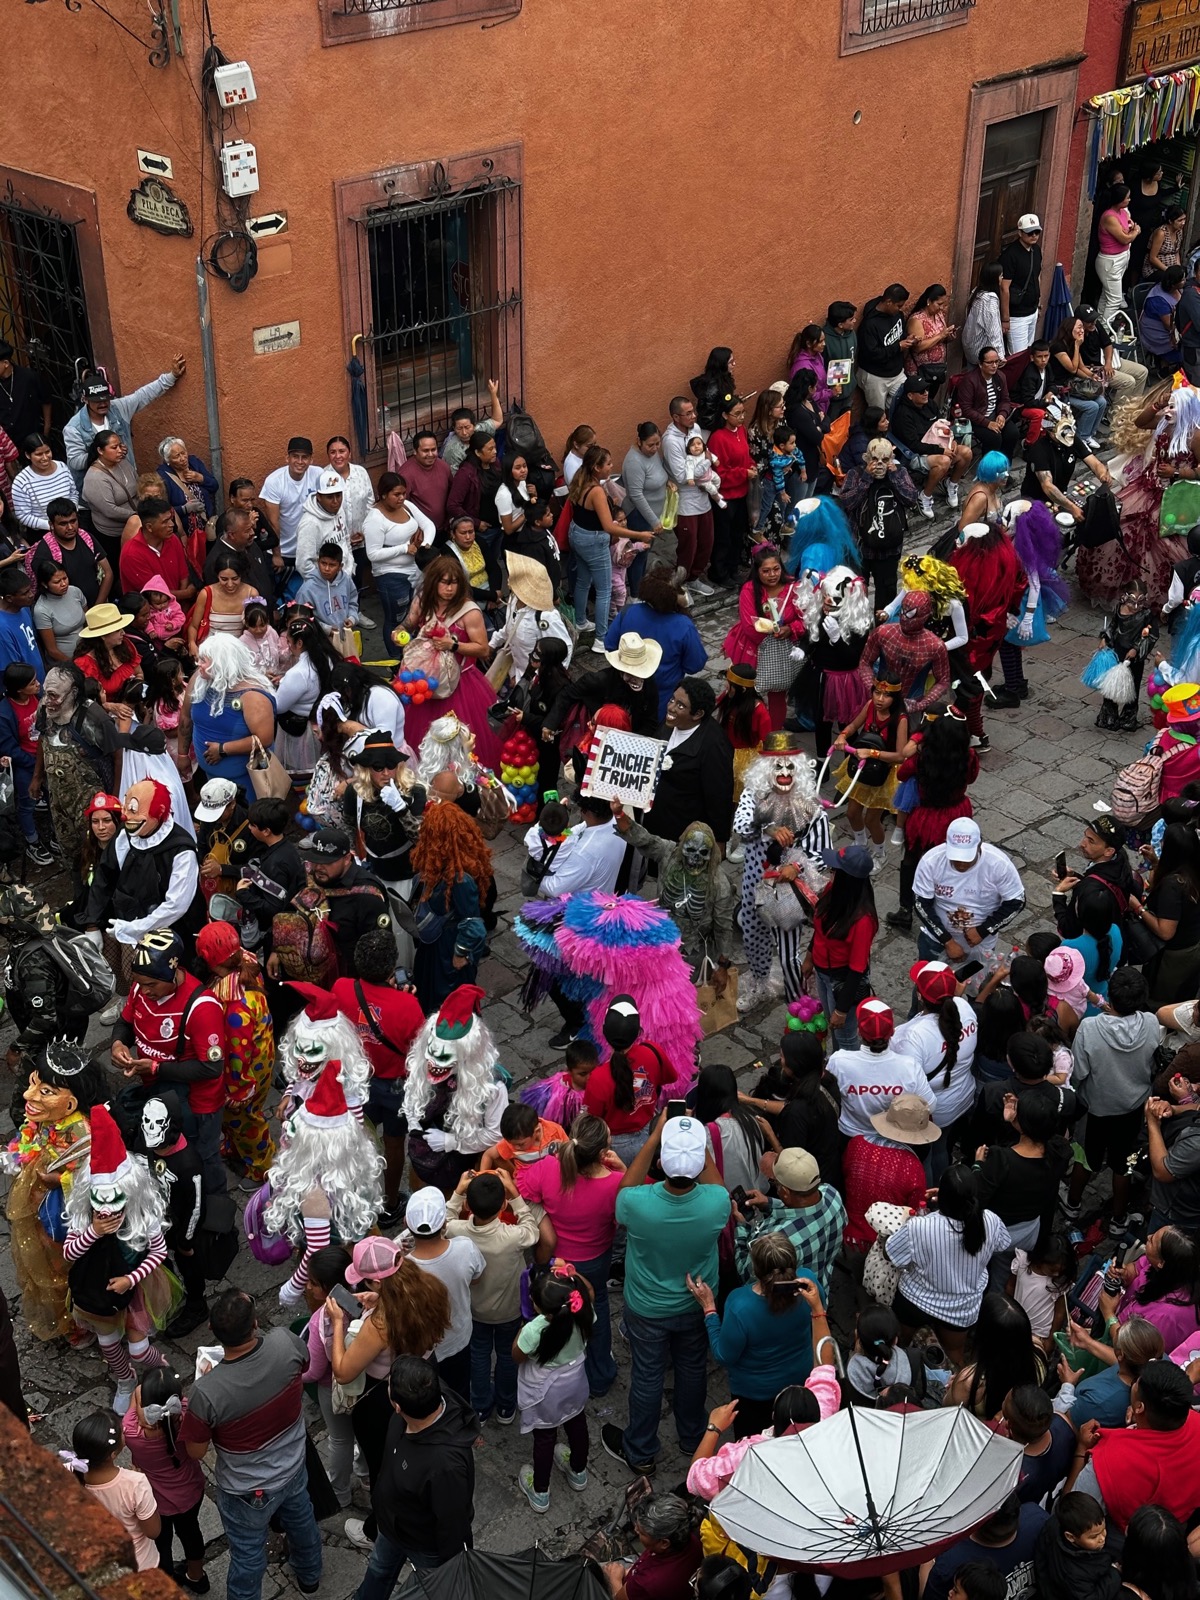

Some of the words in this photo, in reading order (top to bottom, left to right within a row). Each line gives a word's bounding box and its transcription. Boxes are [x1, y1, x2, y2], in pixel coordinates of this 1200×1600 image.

[1134, 34, 1171, 71] PLAZA
[141, 198, 158, 212] PILA
[161, 205, 180, 219] SECA
[877, 500, 885, 538] adidas
[323, 594, 348, 616] GAP
[19, 622, 35, 651] LA
[600, 744, 655, 775] PINCHE
[598, 766, 651, 793] TRUMP
[940, 1022, 976, 1053] AOYO
[847, 1084, 904, 1096] APOYO
